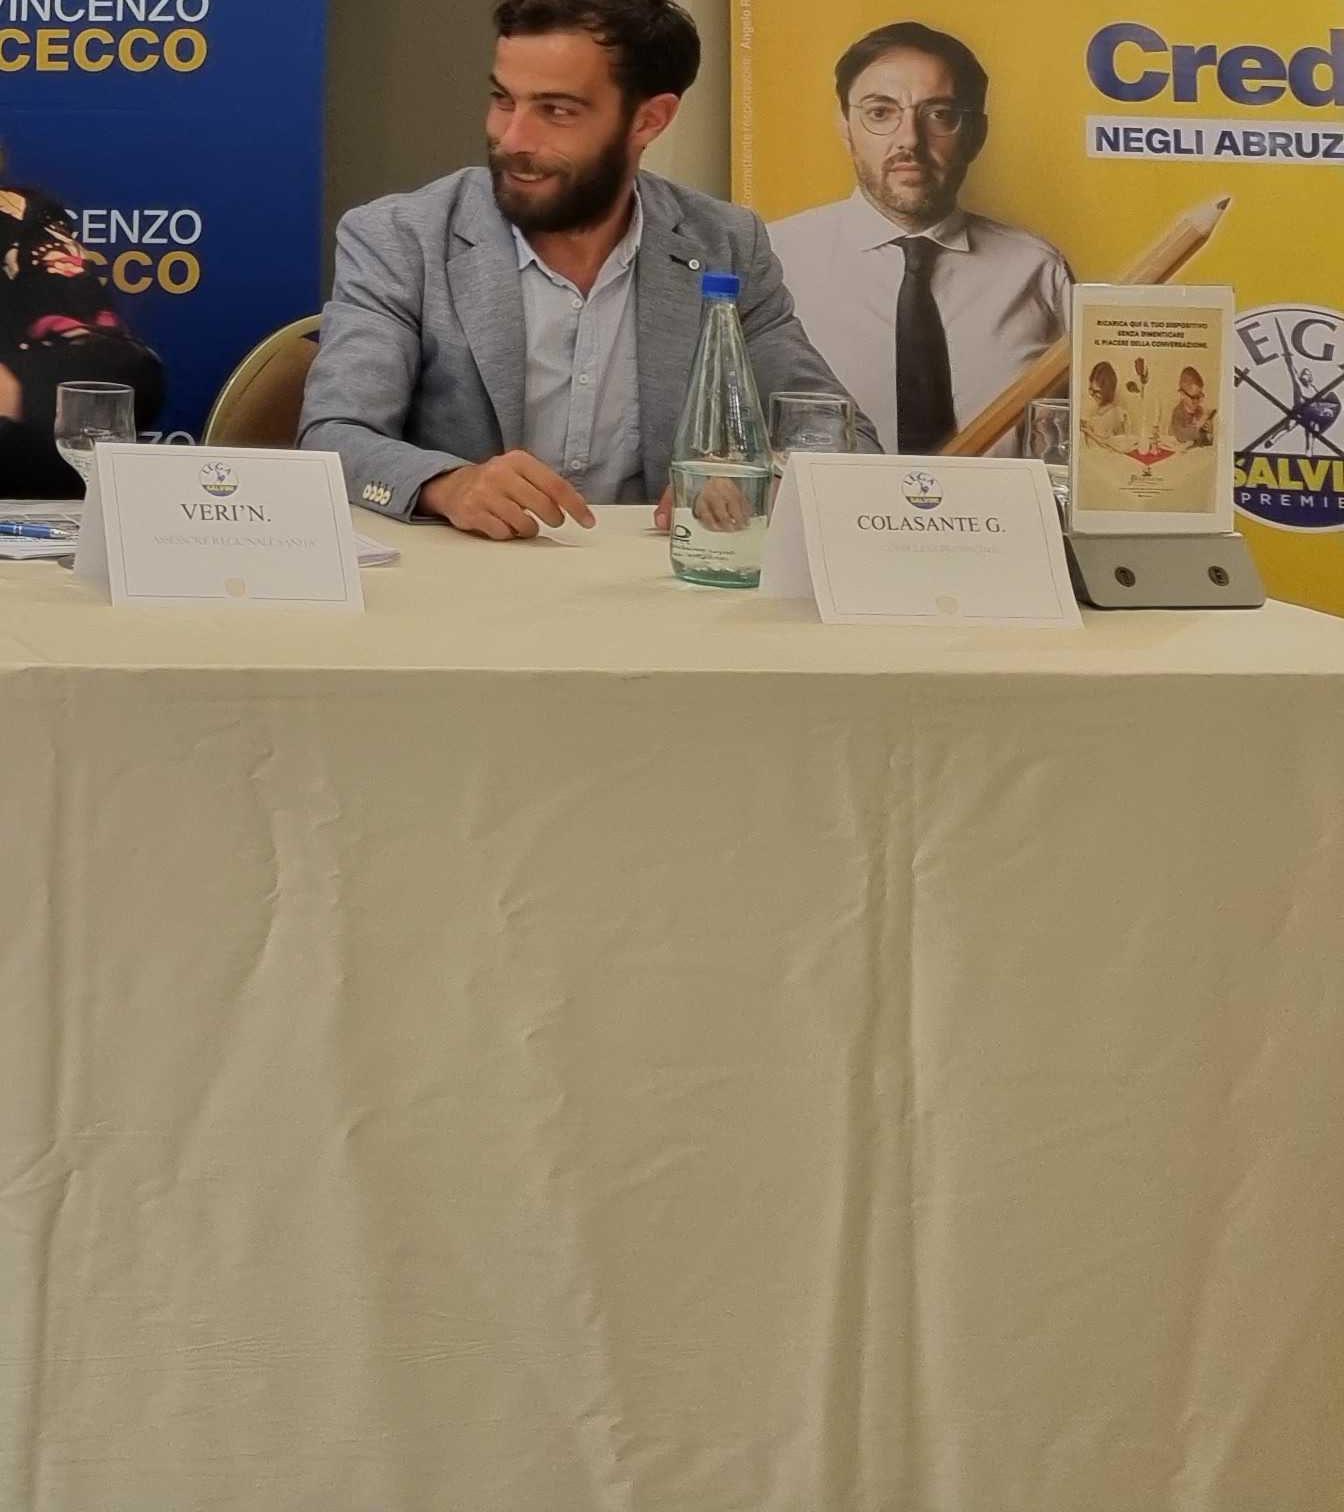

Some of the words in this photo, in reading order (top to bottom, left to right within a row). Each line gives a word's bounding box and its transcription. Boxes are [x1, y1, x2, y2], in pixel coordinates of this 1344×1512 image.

[739, 10, 754, 49] Angelo
[1095, 126, 1204, 155] NEGLI
[64, 208, 202, 245] ENZO
[857, 514, 980, 533] COLASANTE
[986, 517, 1006, 533] G.
